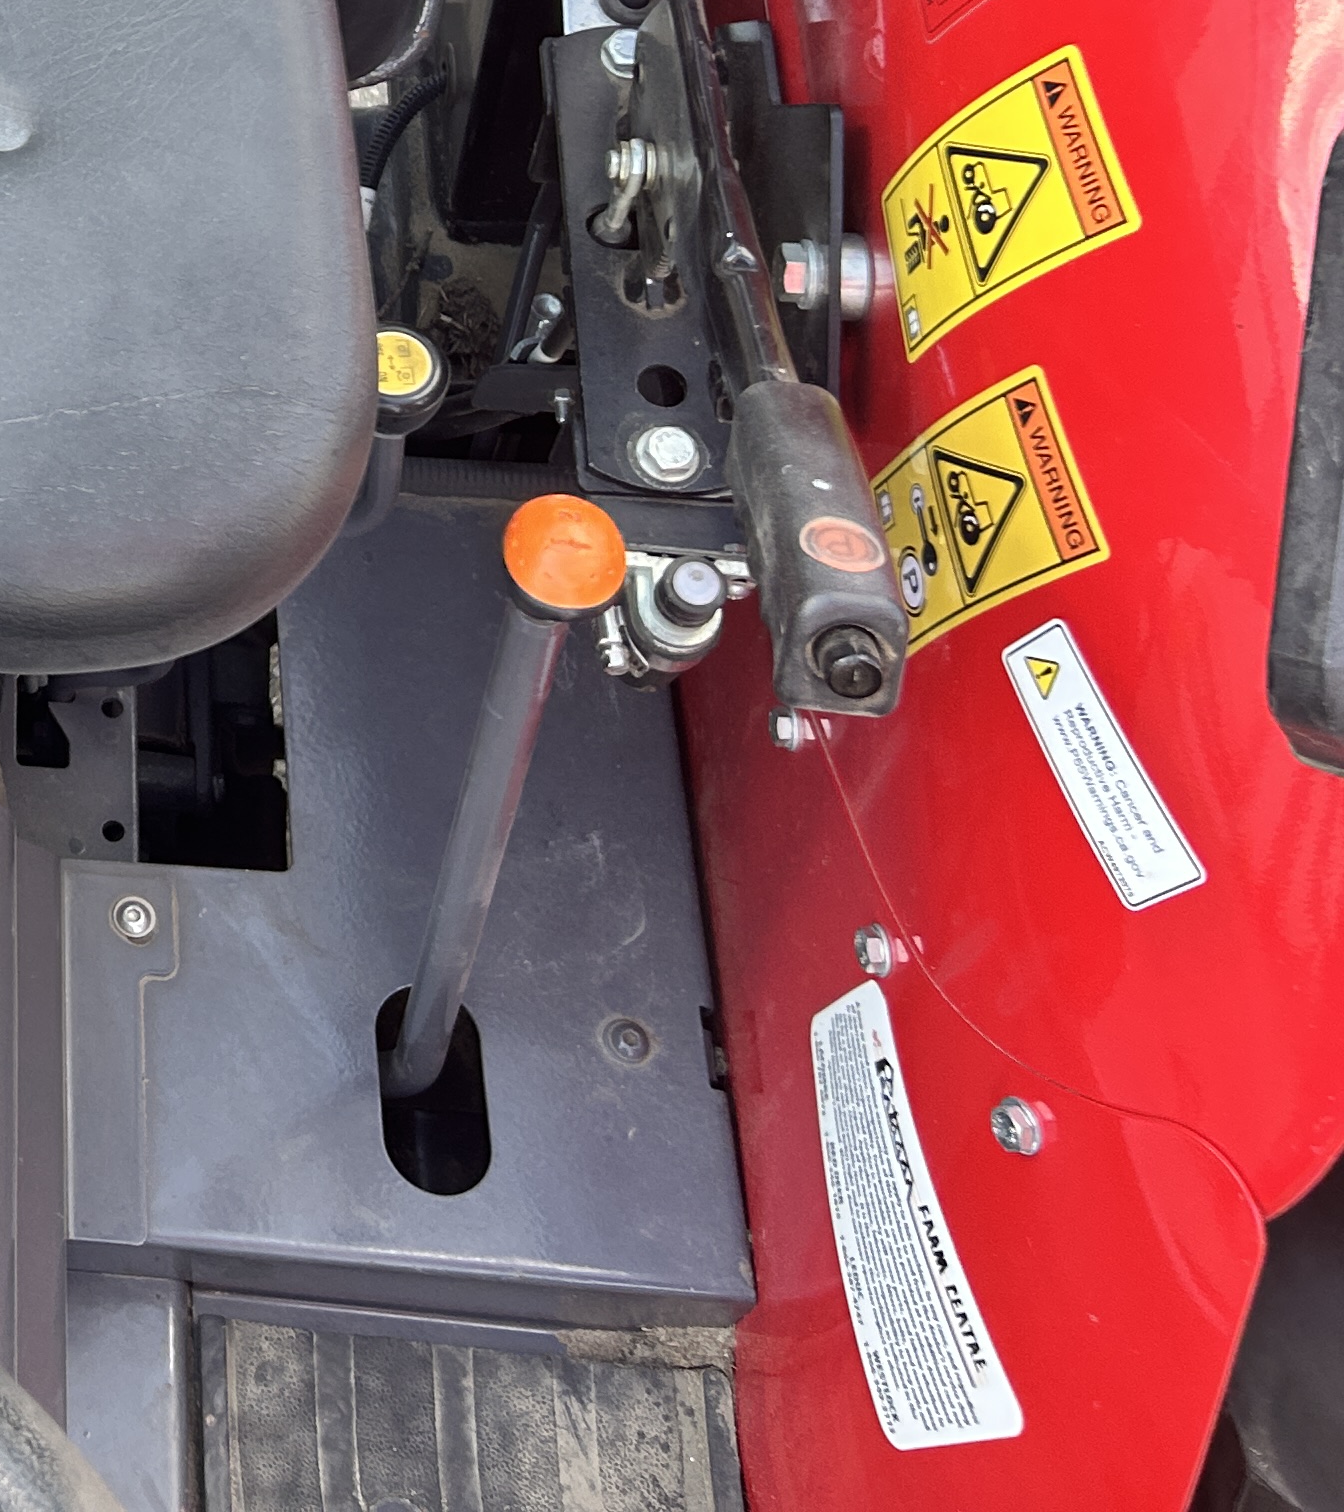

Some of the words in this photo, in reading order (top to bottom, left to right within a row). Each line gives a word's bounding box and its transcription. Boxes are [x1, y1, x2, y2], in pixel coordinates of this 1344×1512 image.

[1057, 106, 1114, 224] WARNING
[1030, 426, 1085, 552] WARNING
[903, 568, 918, 593] P
[1064, 709, 1112, 793] Reproductive
[1109, 794, 1134, 831] Harm
[1075, 702, 1120, 777] WARNING:
[1115, 779, 1147, 826] Cancer
[1142, 828, 1164, 854] and
